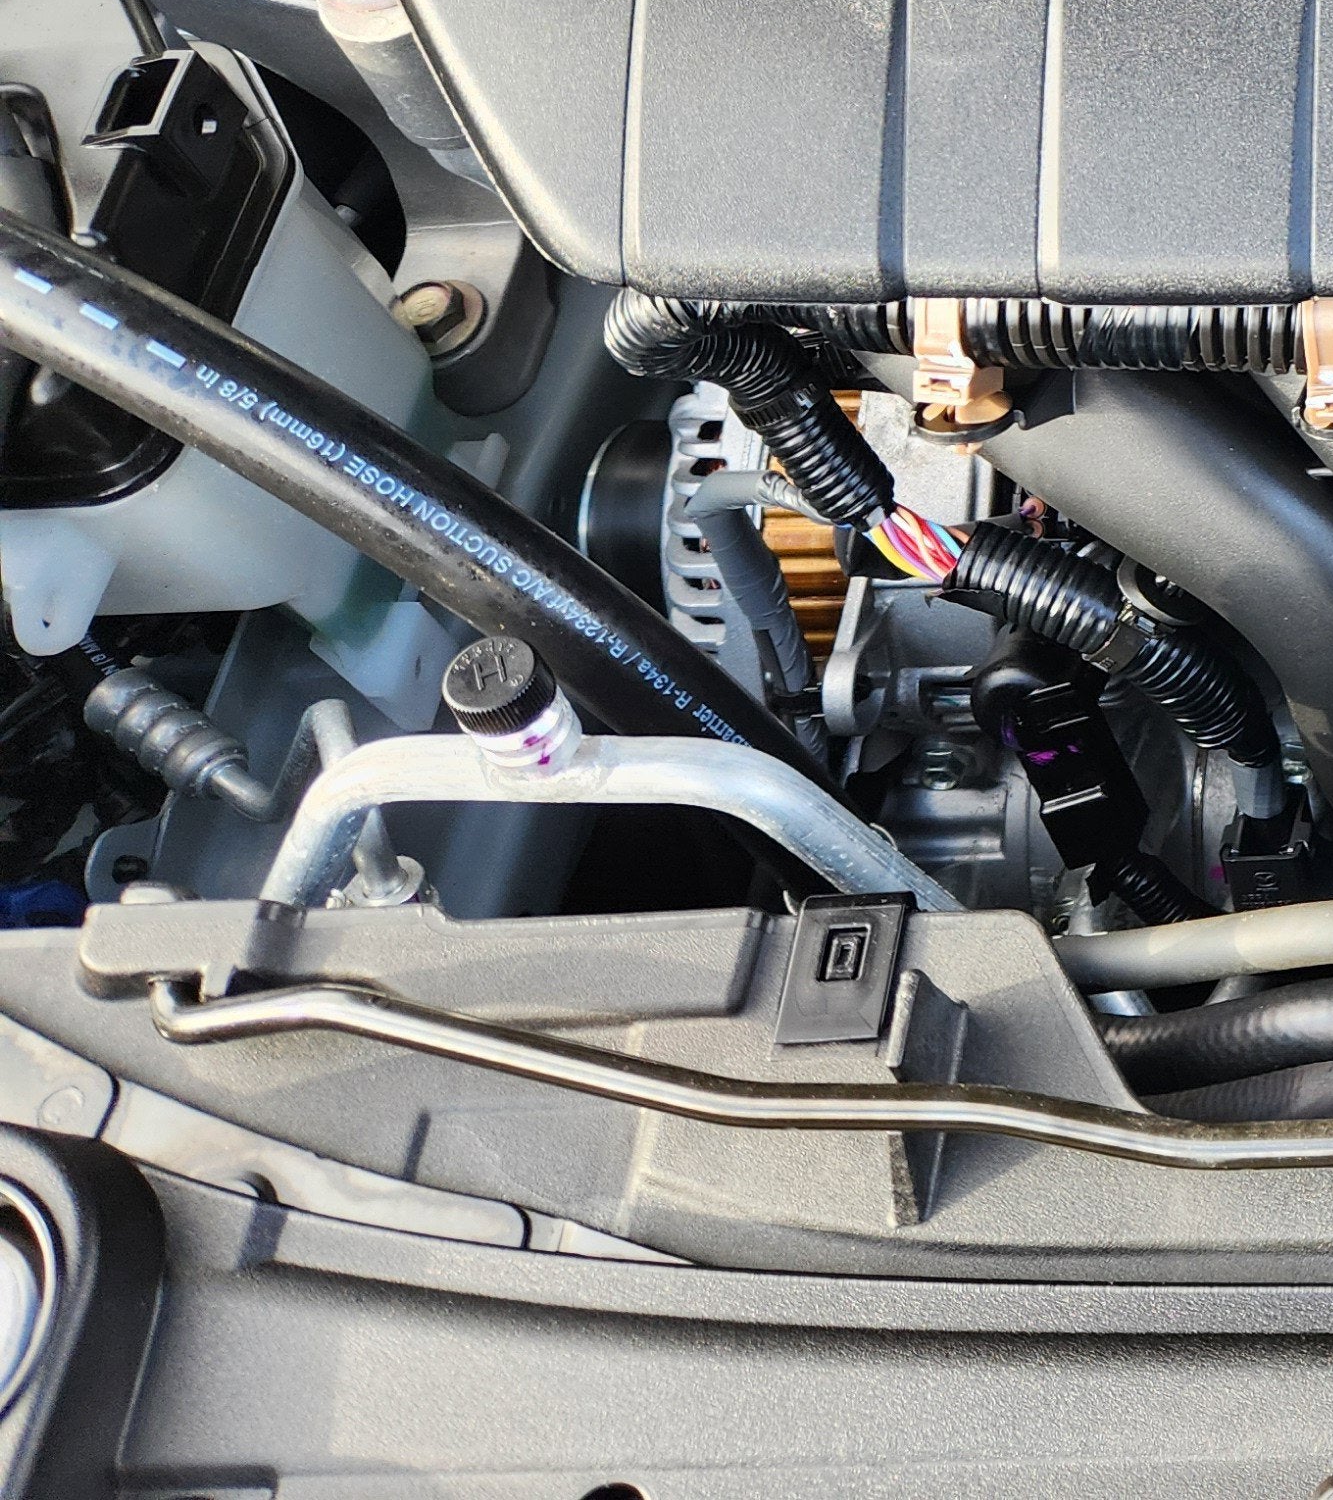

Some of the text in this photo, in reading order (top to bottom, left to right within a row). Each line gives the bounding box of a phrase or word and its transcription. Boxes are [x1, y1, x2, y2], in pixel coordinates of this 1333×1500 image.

[196, 364, 220, 388] in
[218, 379, 259, 411] 5/8
[258, 401, 346, 462] (16mm)
[343, 455, 415, 507] HOSE
[413, 499, 514, 574] SUCTION
[511, 567, 552, 601] A/C
[637, 659, 693, 710] R-134a
